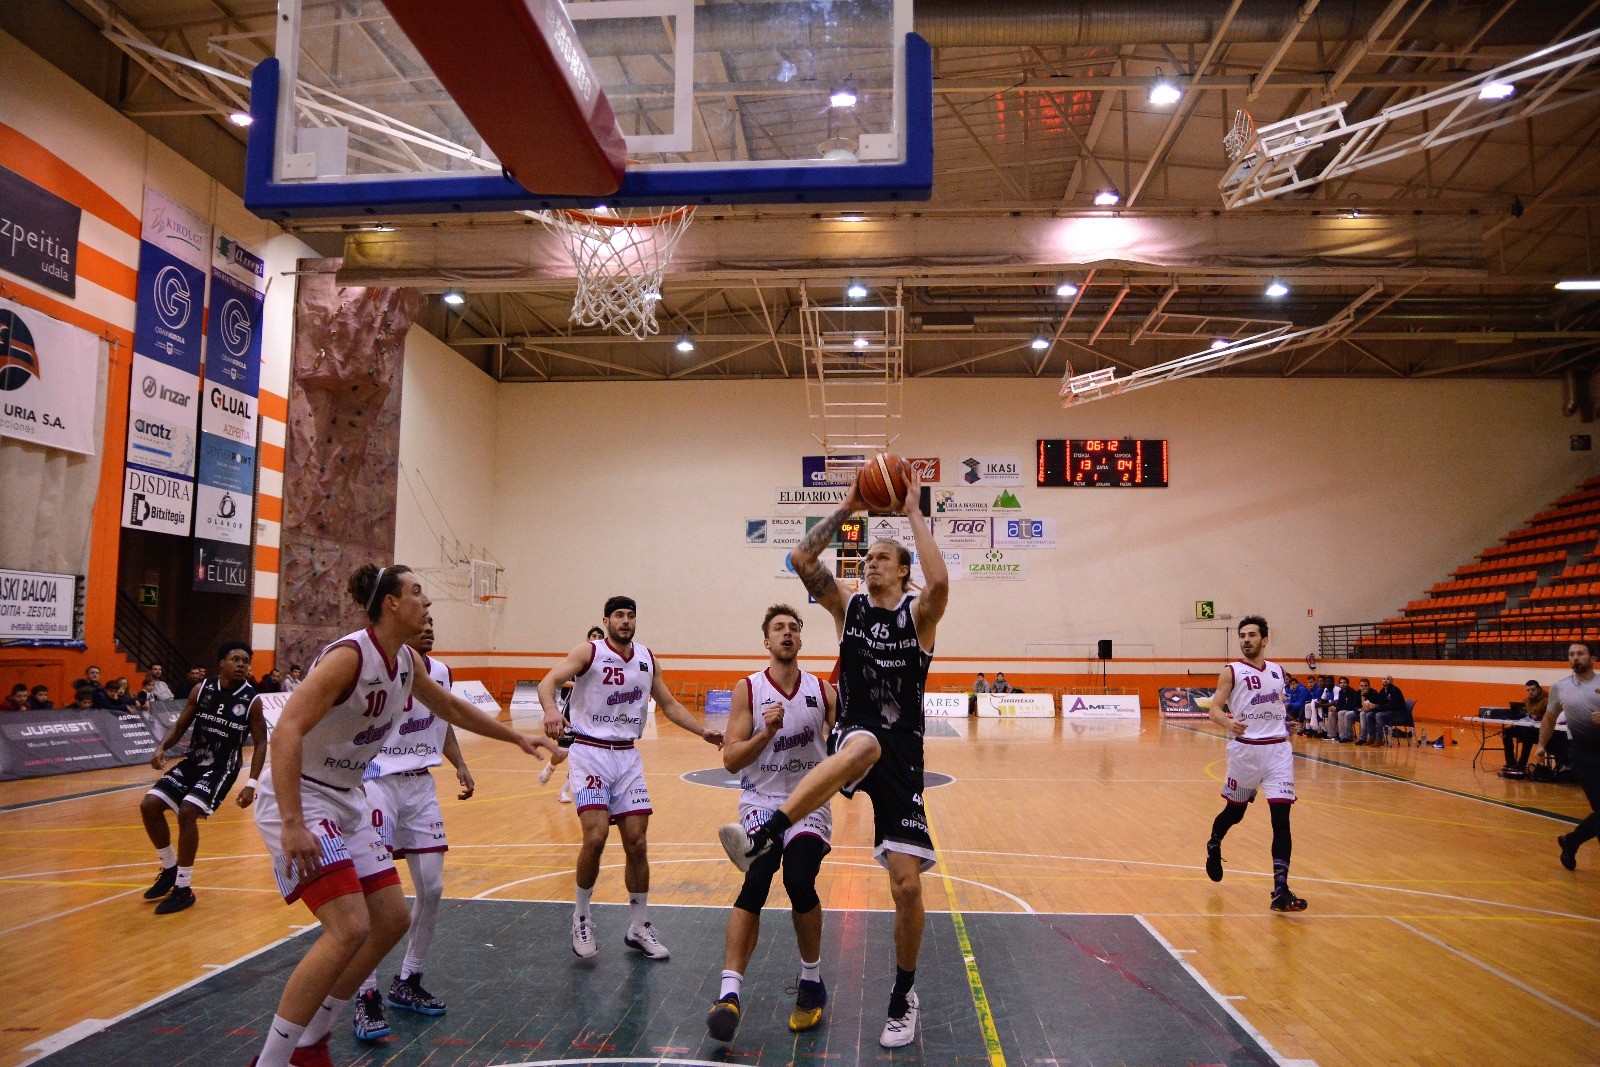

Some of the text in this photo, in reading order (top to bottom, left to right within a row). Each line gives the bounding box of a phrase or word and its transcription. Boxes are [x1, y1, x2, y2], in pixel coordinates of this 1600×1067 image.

[166, 217, 202, 246] KIROLGI
[41, 261, 69, 282] udala
[211, 387, 251, 419] GLUAL
[4, 404, 65, 430] URIA S.A.
[134, 419, 171, 441] aratz
[1086, 440, 1118, 451] 06:12
[986, 463, 1016, 473] IKASI
[1080, 459, 1091, 470] 13
[1117, 460, 1133, 470] 04
[1076, 473, 1083, 481] 2
[1122, 473, 1129, 481] 2
[129, 471, 190, 501] DISDIRA
[780, 491, 794, 502] EL
[795, 491, 831, 502] DIARIO
[151, 506, 185, 525] Bitxitegia
[847, 531, 858, 541] 19
[1008, 520, 1042, 538] ate
[207, 565, 247, 585] ELIKU
[969, 564, 1020, 572] IZARRAITZ
[21, 579, 57, 603] BALOIA
[27, 606, 56, 618] ZESTOA
[870, 621, 890, 640] 45
[846, 626, 917, 651] JURISTI ISB
[602, 666, 624, 686] 25
[1243, 675, 1262, 691] 19
[216, 703, 225, 716] 2
[362, 689, 388, 718] 10
[925, 698, 960, 707] ARES
[1068, 696, 1121, 713] AMET
[592, 714, 620, 723] RIOJA
[21, 721, 94, 736] JUARISTI
[380, 746, 416, 755] RIOJA
[323, 757, 367, 771] RIOJA
[760, 764, 789, 773] RIOJA
[586, 774, 602, 790] 25
[1227, 777, 1238, 791] 19
[371, 809, 383, 827] 0
